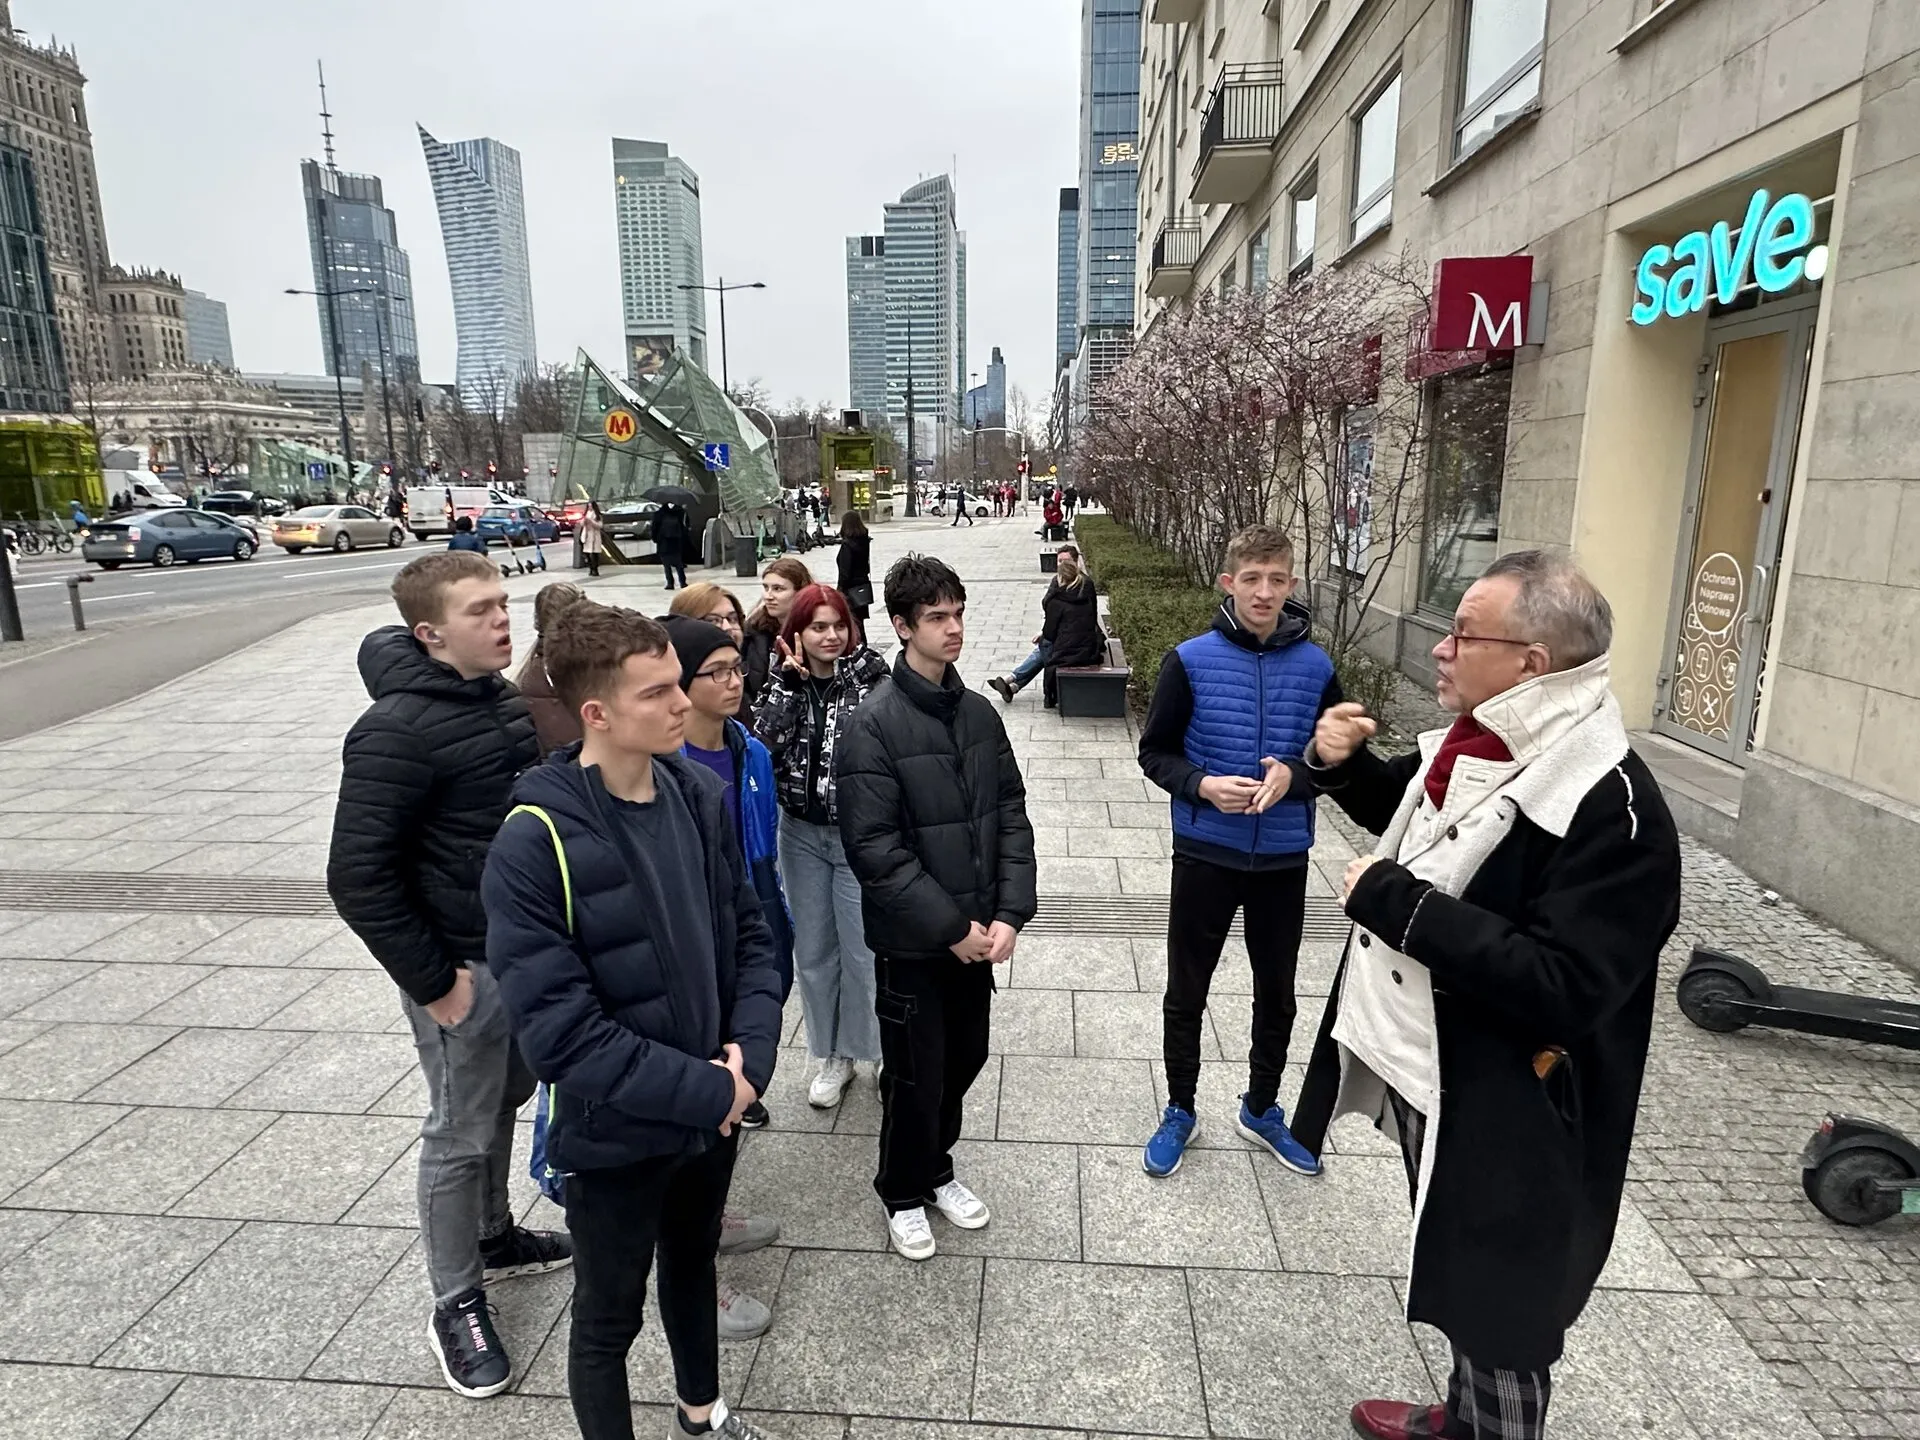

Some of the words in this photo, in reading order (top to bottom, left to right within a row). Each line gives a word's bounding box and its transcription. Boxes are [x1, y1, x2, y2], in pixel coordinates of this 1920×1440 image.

[1466, 291, 1522, 348] M
[608, 415, 631, 436] M
[1702, 571, 1736, 586] Ochrona
[1700, 586, 1735, 602] Naprawa
[1697, 602, 1731, 618] Odnowa
[466, 1312, 479, 1327] AIR
